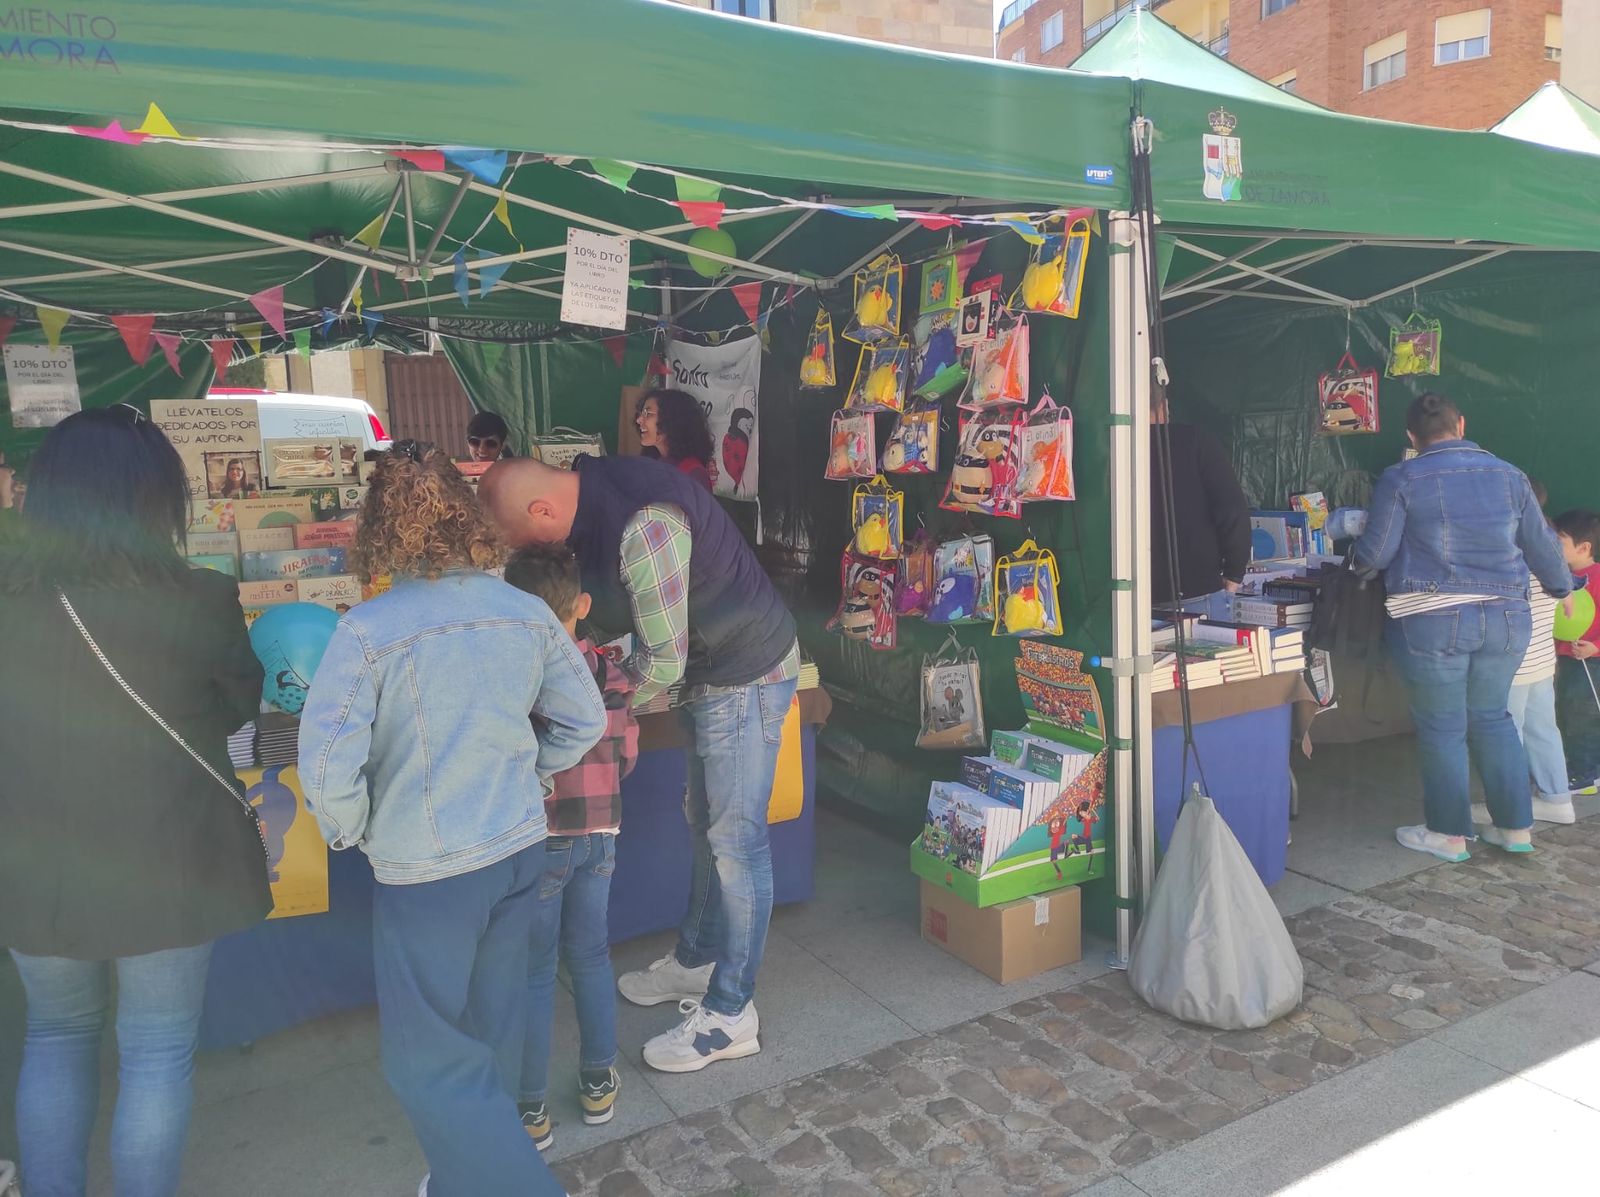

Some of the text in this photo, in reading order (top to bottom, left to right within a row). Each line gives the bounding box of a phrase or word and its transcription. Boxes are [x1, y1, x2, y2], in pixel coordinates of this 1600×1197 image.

[574, 246, 623, 264] 10% DTO
[13, 360, 68, 369] 10% DTO
[166, 406, 244, 417] LLÉVATELOS
[231, 420, 257, 429] POR
[173, 434, 244, 444] SU AUTORA
